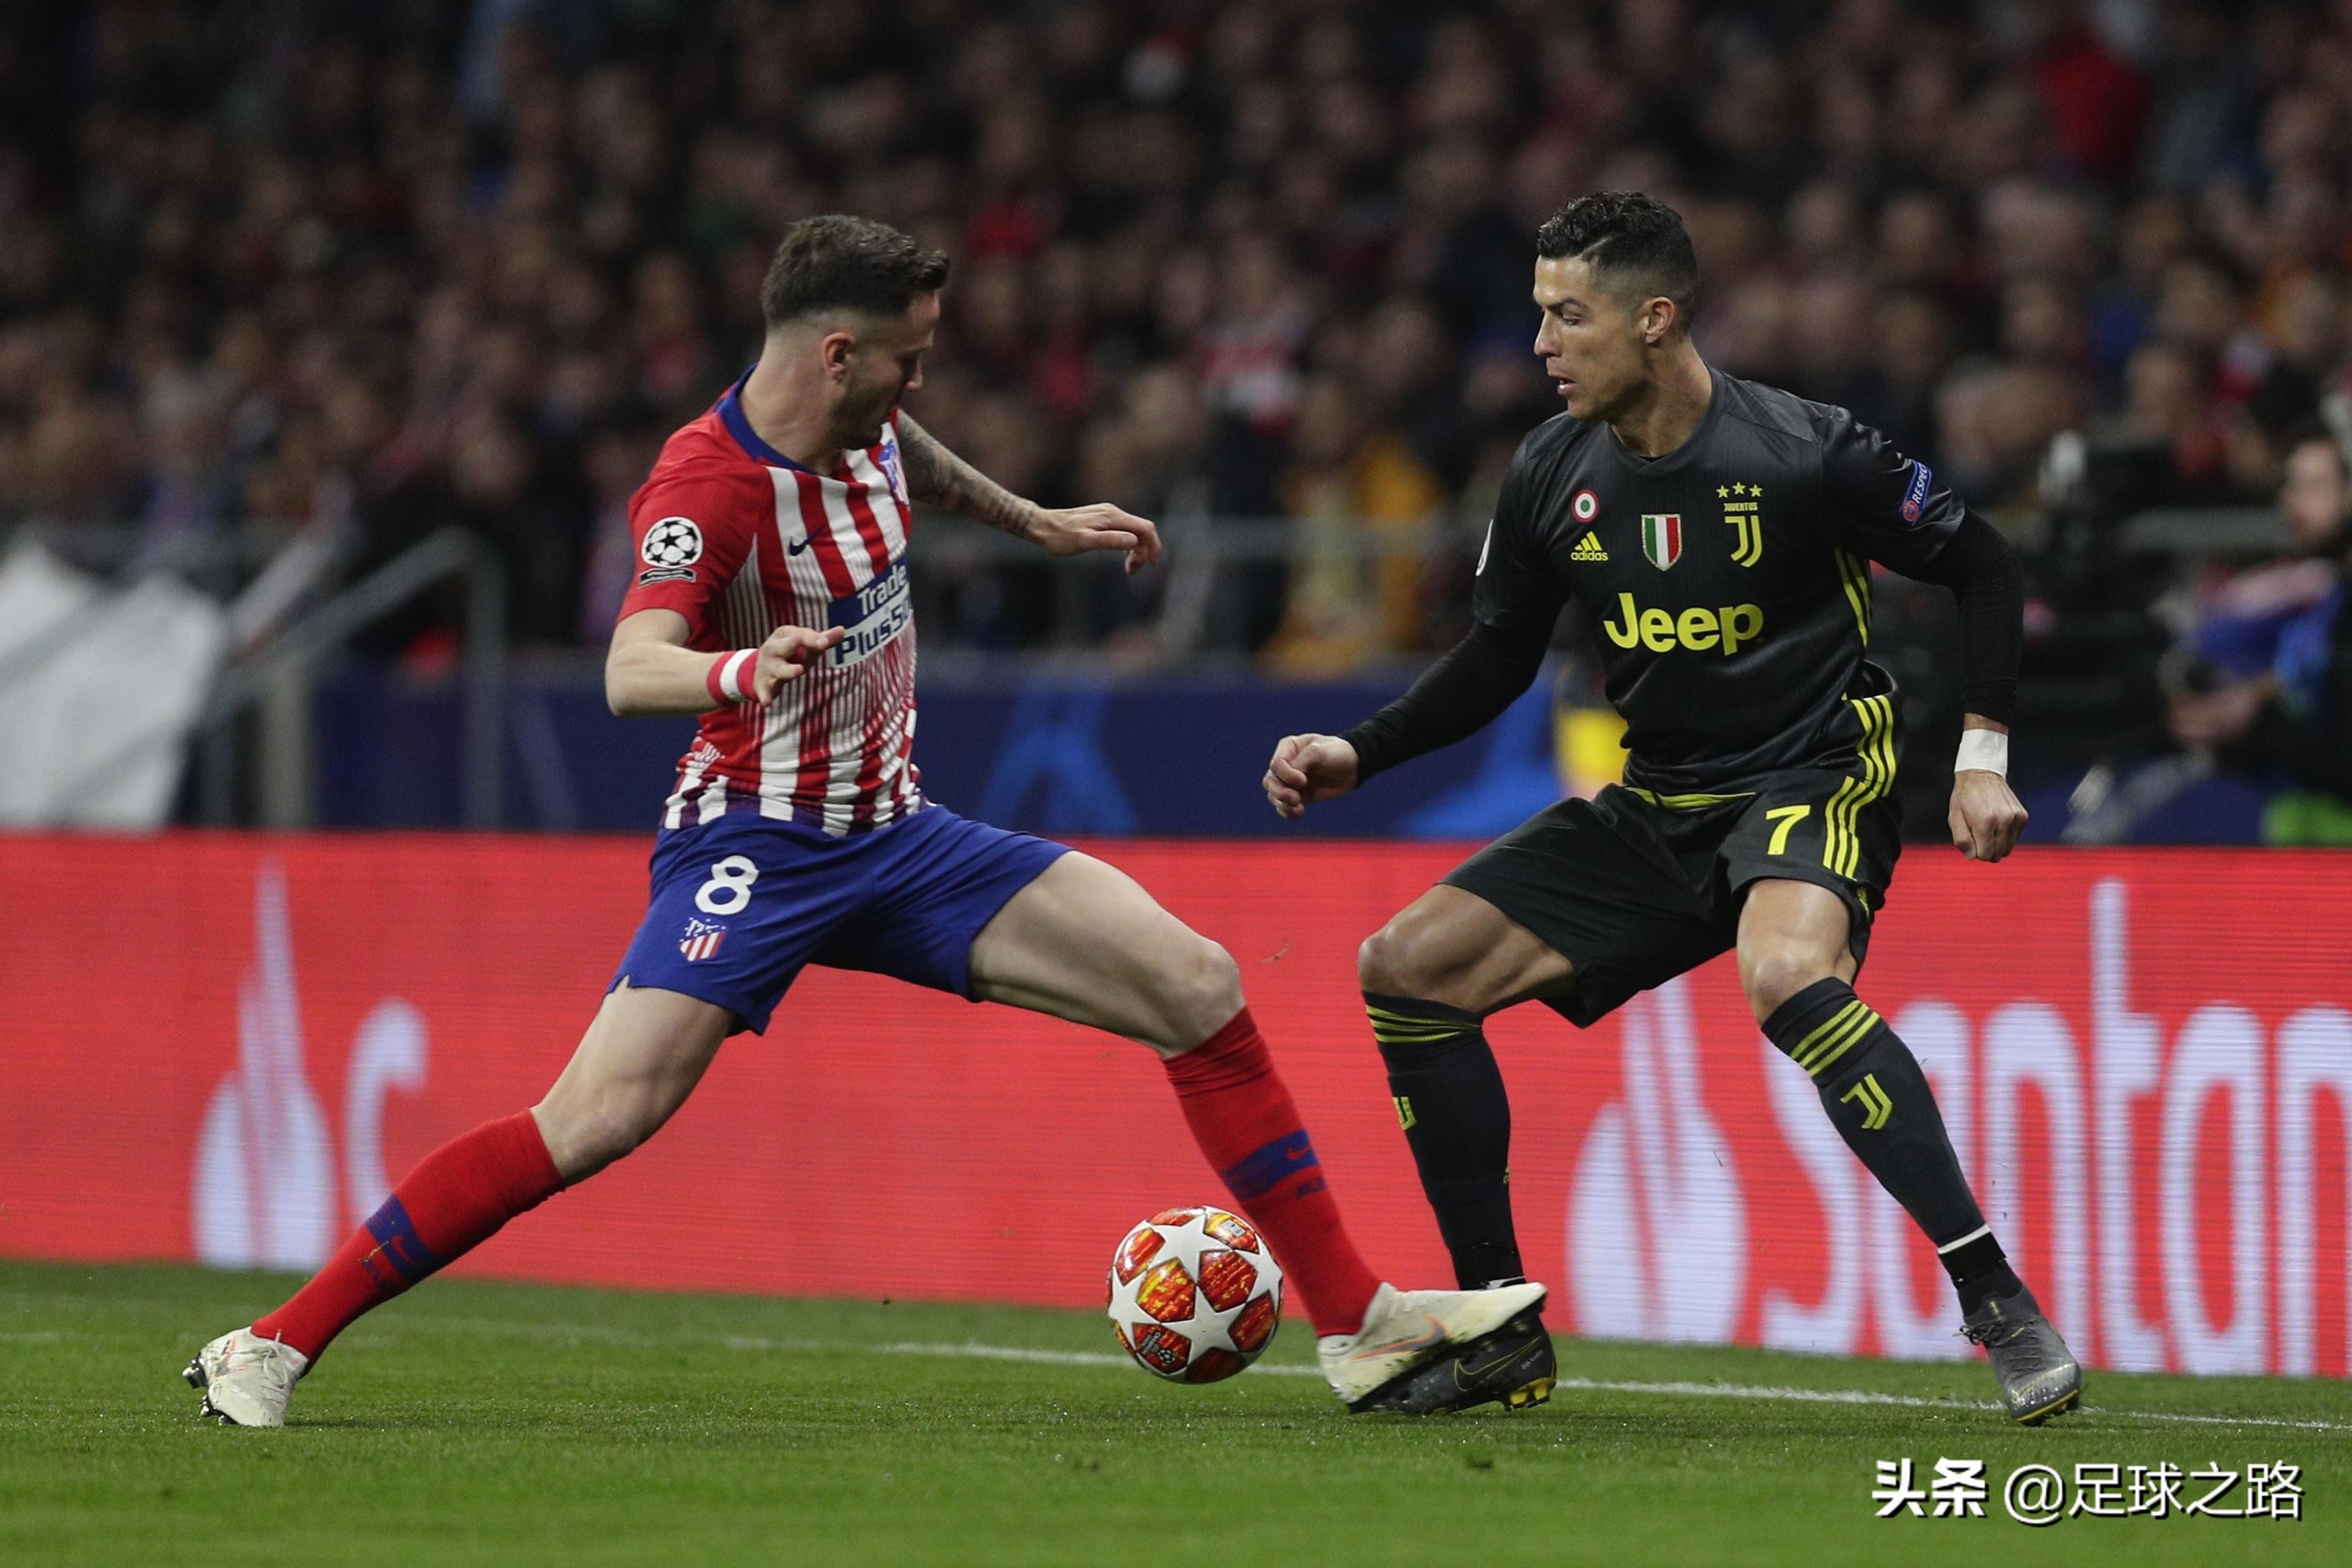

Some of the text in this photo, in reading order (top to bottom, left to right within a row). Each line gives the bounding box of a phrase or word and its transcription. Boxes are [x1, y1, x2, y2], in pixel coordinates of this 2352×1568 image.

[1723, 501, 1758, 511] JUVENTUS
[1571, 548, 1608, 561] adidas
[857, 564, 907, 616] Trade
[1603, 592, 1764, 656] Jeep
[1766, 805, 1811, 855] 7
[694, 854, 760, 916] 8
